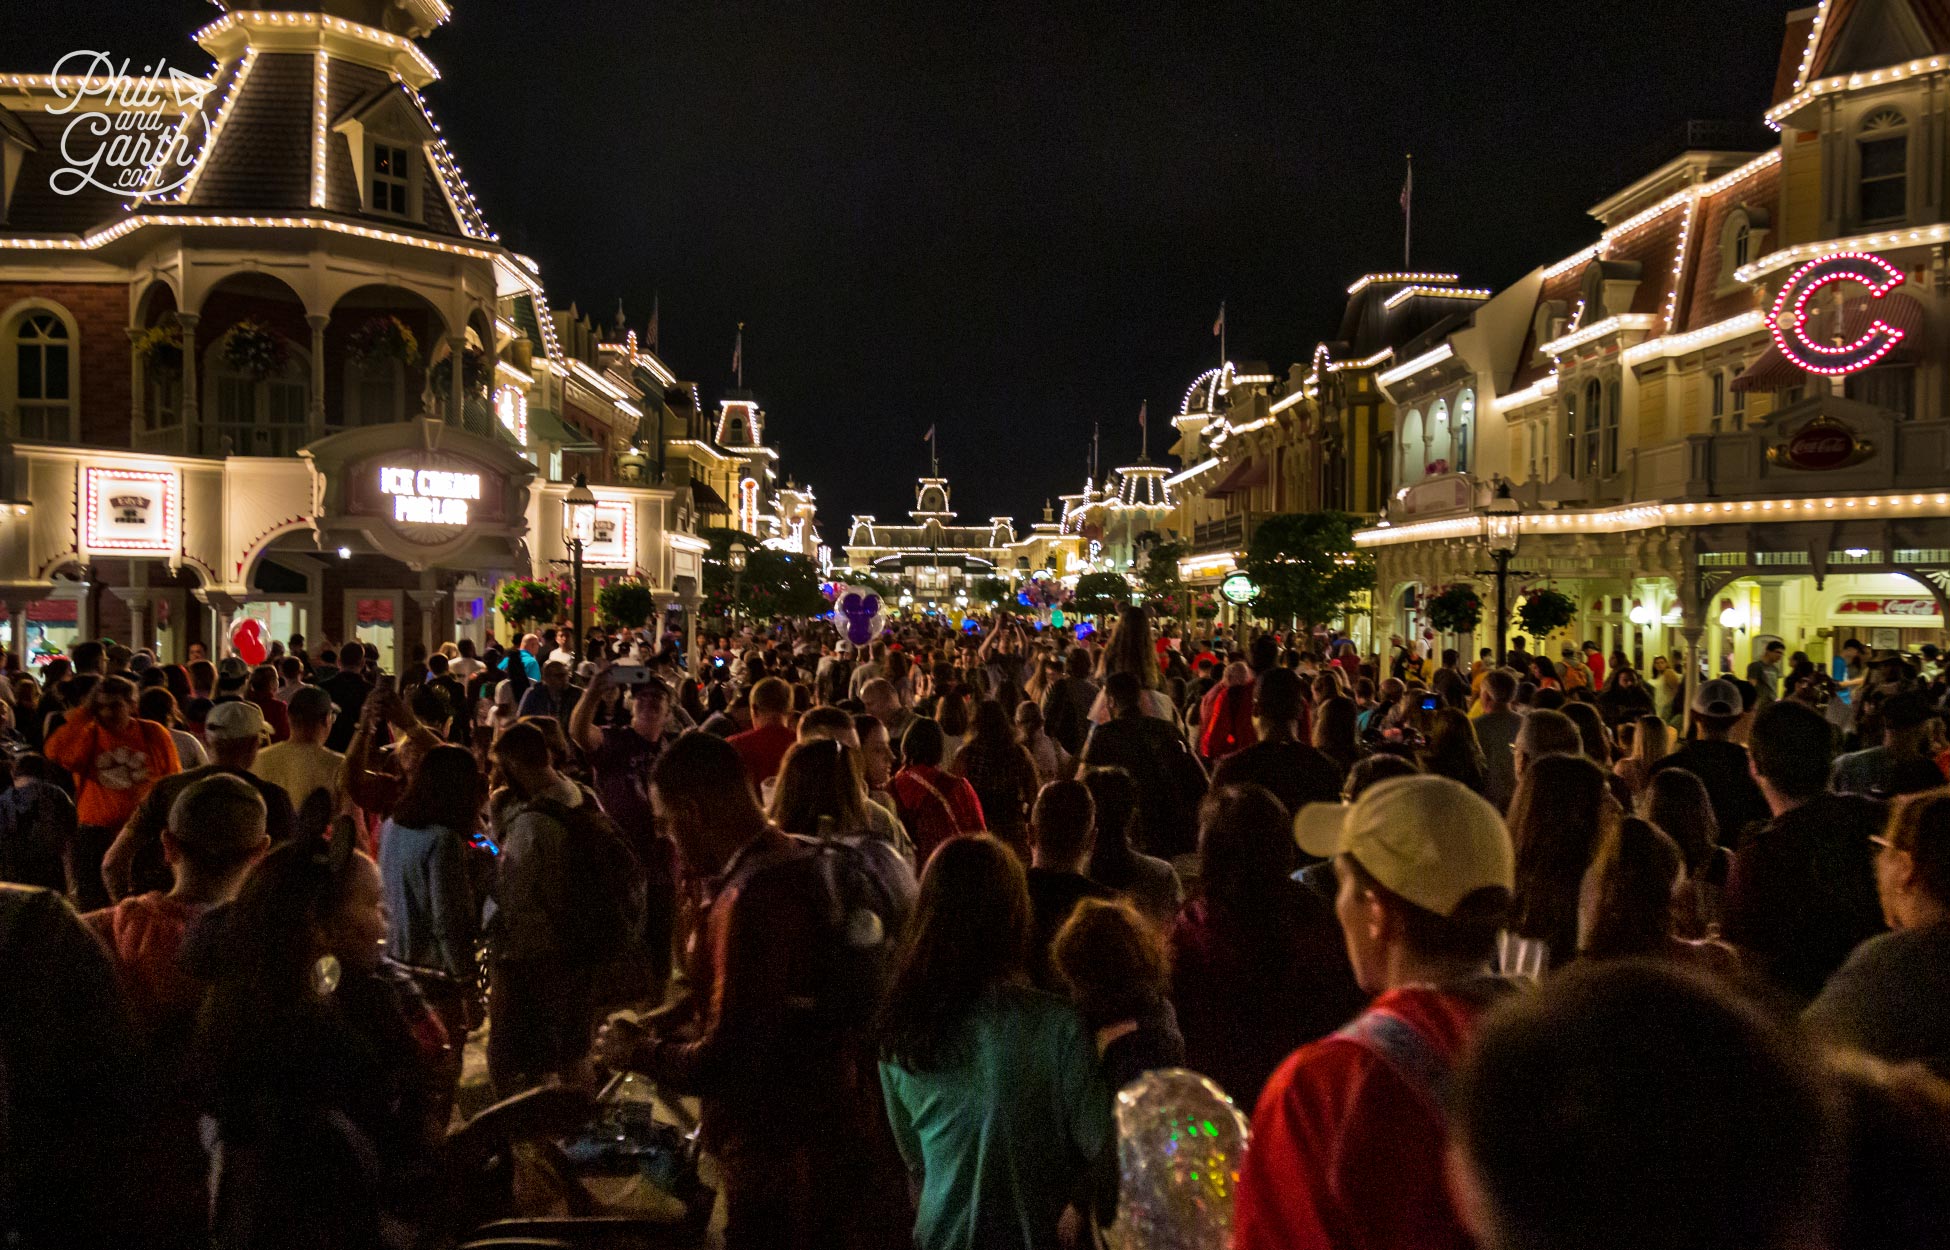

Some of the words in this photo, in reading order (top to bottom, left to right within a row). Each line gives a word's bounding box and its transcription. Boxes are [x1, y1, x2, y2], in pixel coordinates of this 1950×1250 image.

[1764, 252, 1905, 376] C
[379, 467, 415, 496] ICE
[416, 470, 480, 499] CREAM
[394, 495, 468, 525] PARLOR
